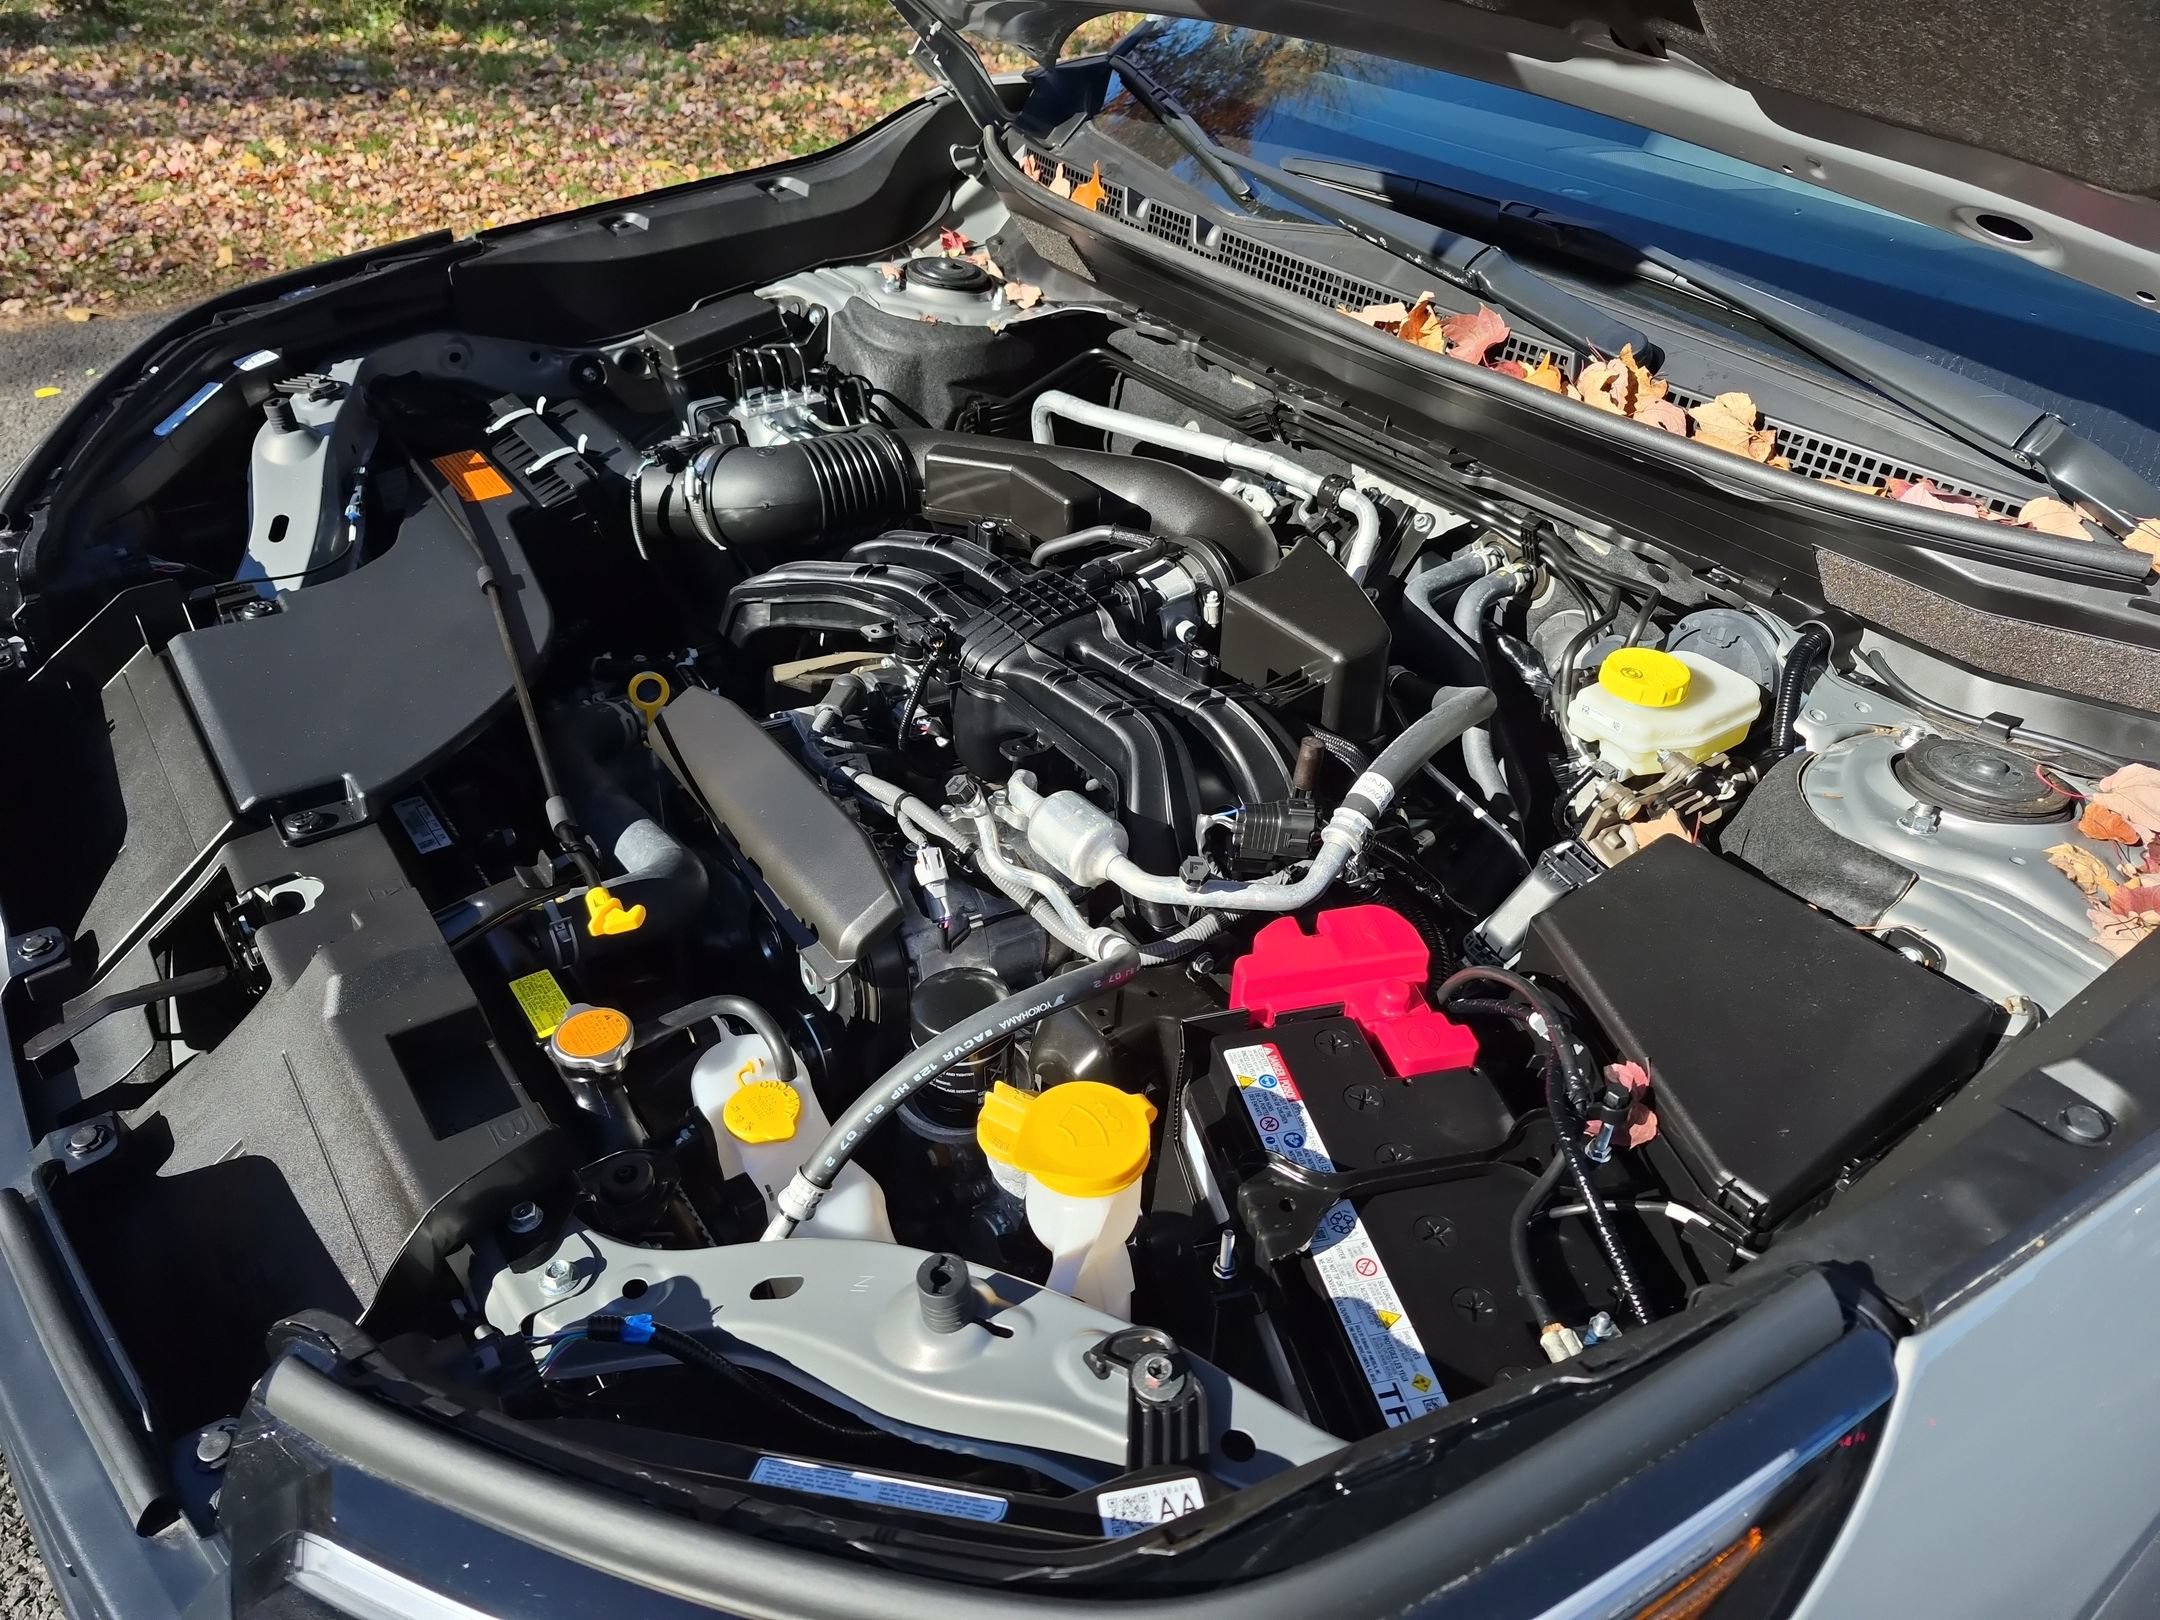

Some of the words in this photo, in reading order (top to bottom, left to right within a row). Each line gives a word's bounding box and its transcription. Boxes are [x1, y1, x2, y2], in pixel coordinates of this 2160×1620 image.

[998, 1000, 1053, 1030] YOKOHAMA
[942, 1032, 985, 1061] ACVR
[1267, 1054, 1286, 1077] DANGER
[1279, 1079, 1297, 1100] POISON
[891, 1082, 910, 1100] HP
[840, 1130, 858, 1151] 07
[824, 1155, 836, 1168] 2
[848, 1274, 875, 1293] IN
[1160, 1493, 1198, 1521] AA
